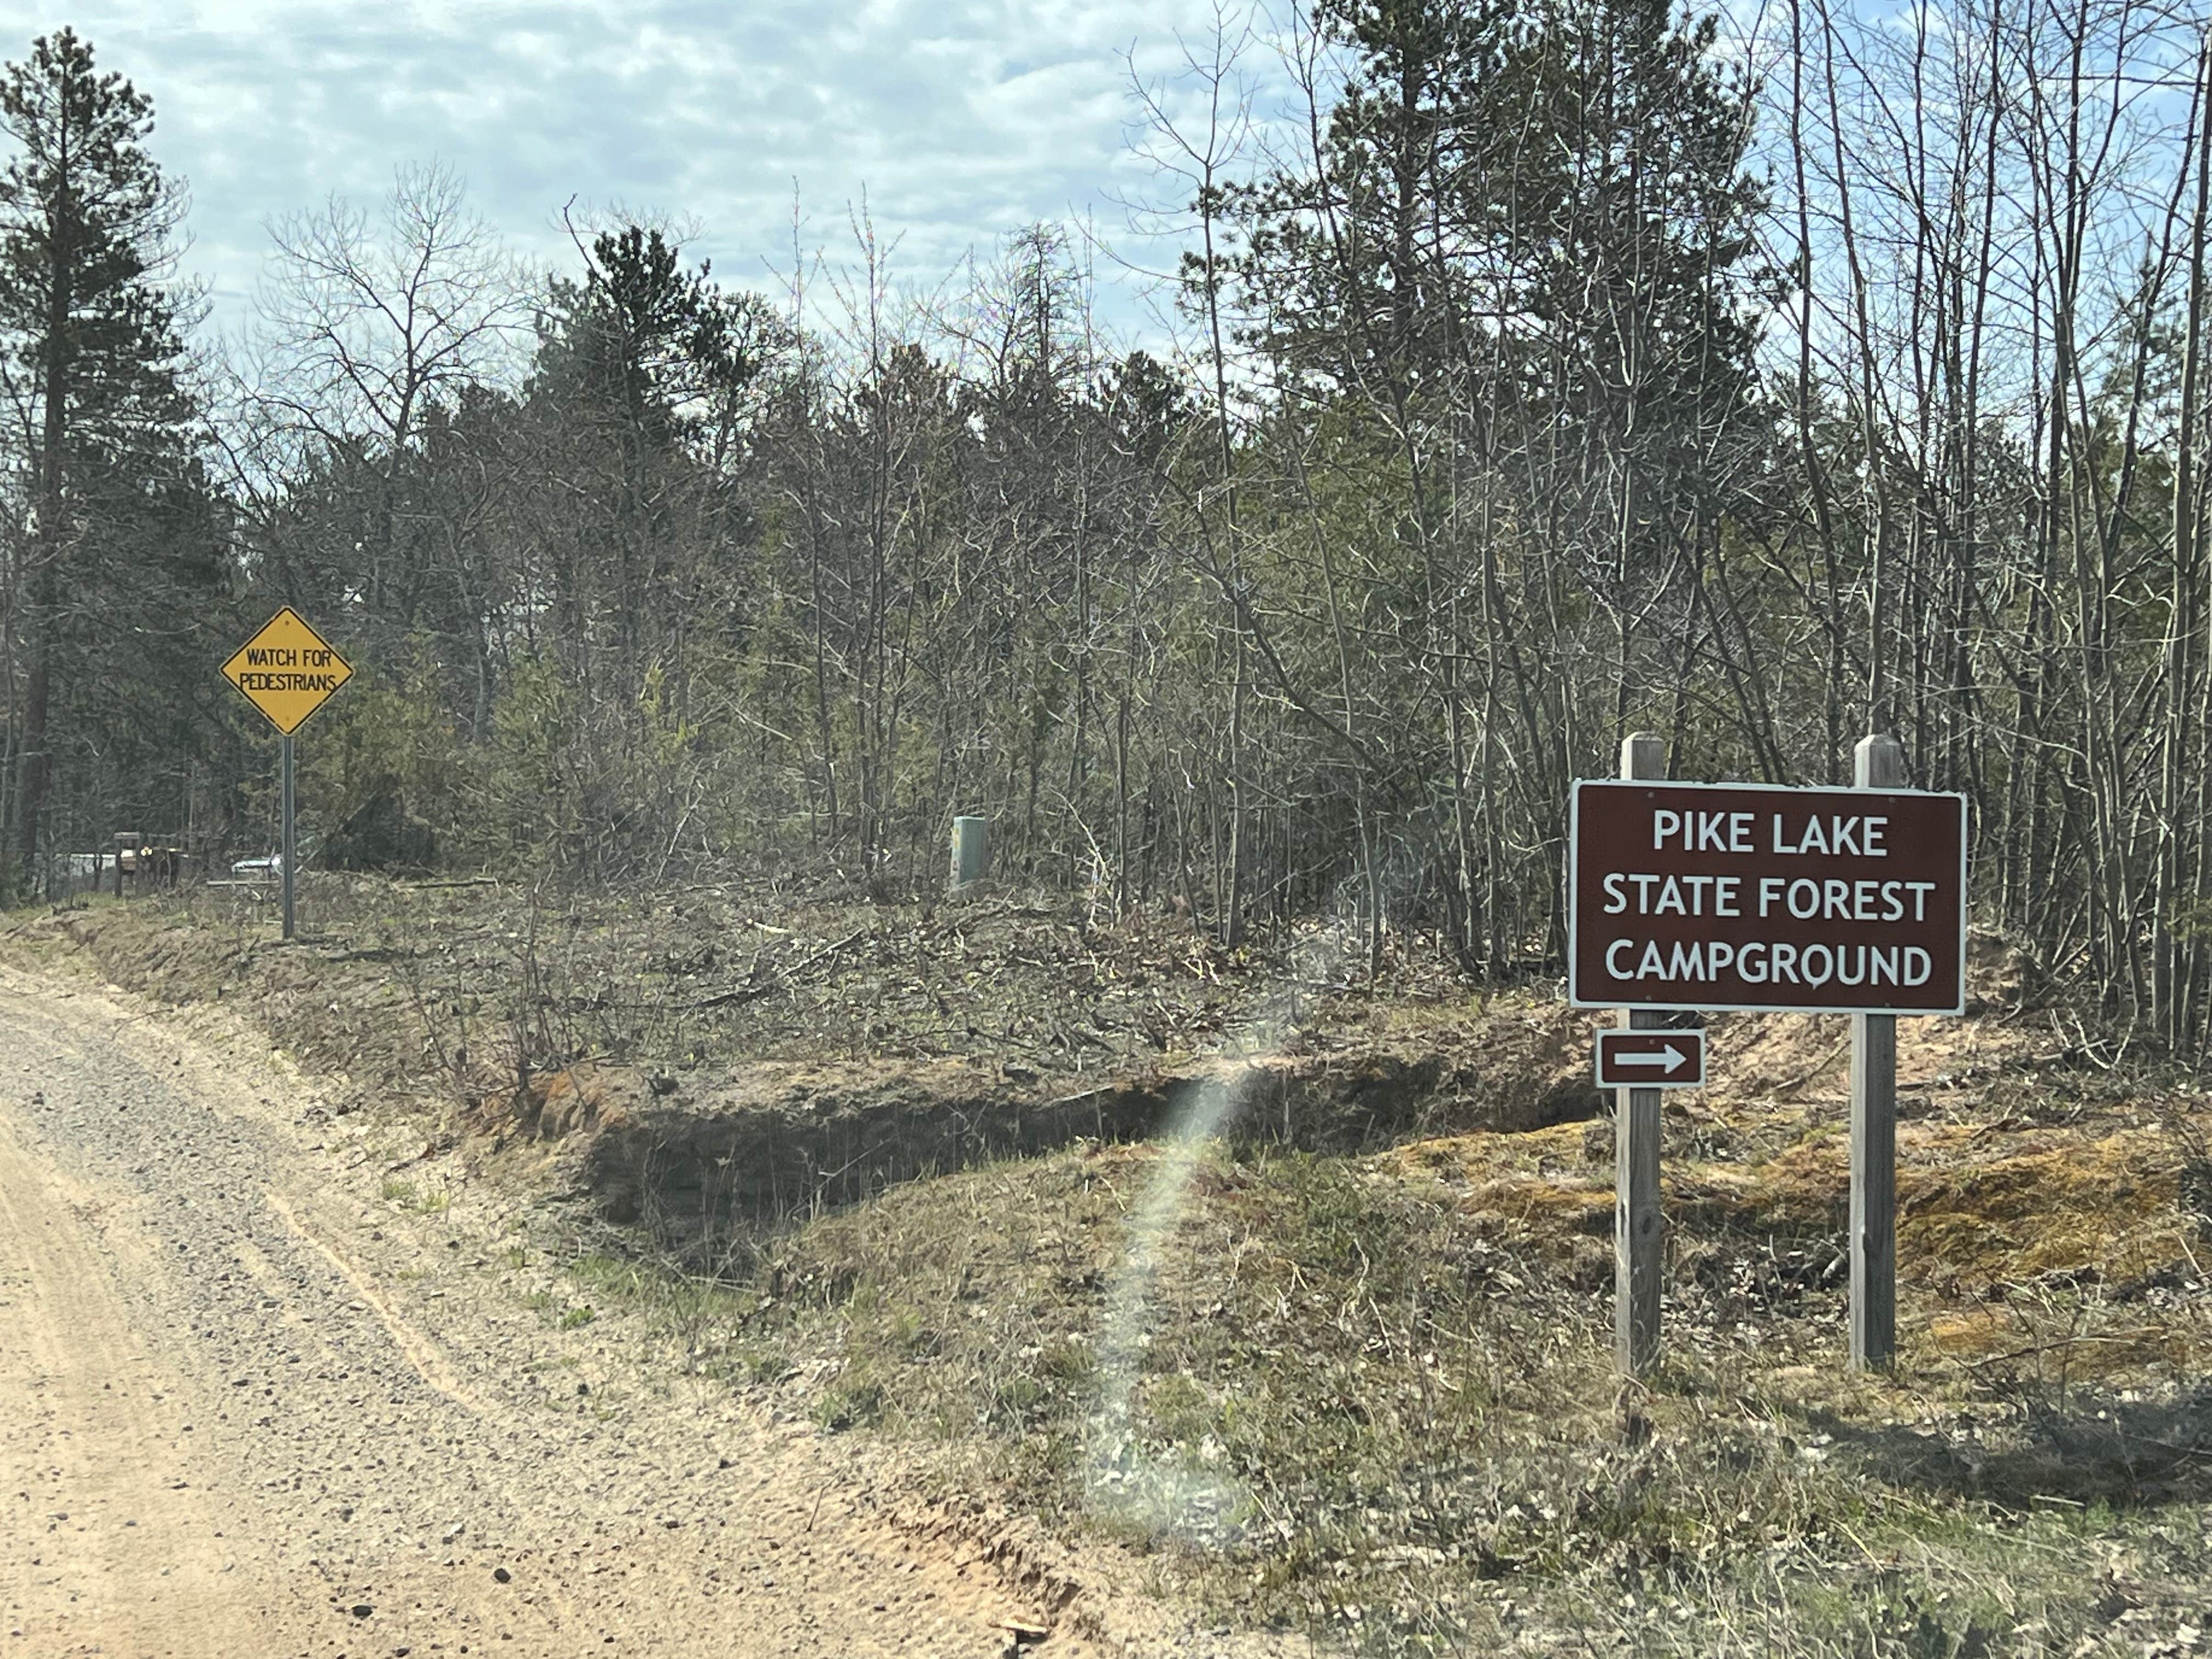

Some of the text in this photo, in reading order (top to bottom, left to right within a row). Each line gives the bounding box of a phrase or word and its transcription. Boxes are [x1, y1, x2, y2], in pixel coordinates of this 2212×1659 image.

[247, 648, 331, 667] WATCH FOR
[240, 673, 336, 691] PEDESTRIANS
[1654, 809, 1888, 856] PIKE LAKE
[1603, 873, 1936, 922] STATE FOREST
[1605, 939, 1932, 987] CAMPGROUND
